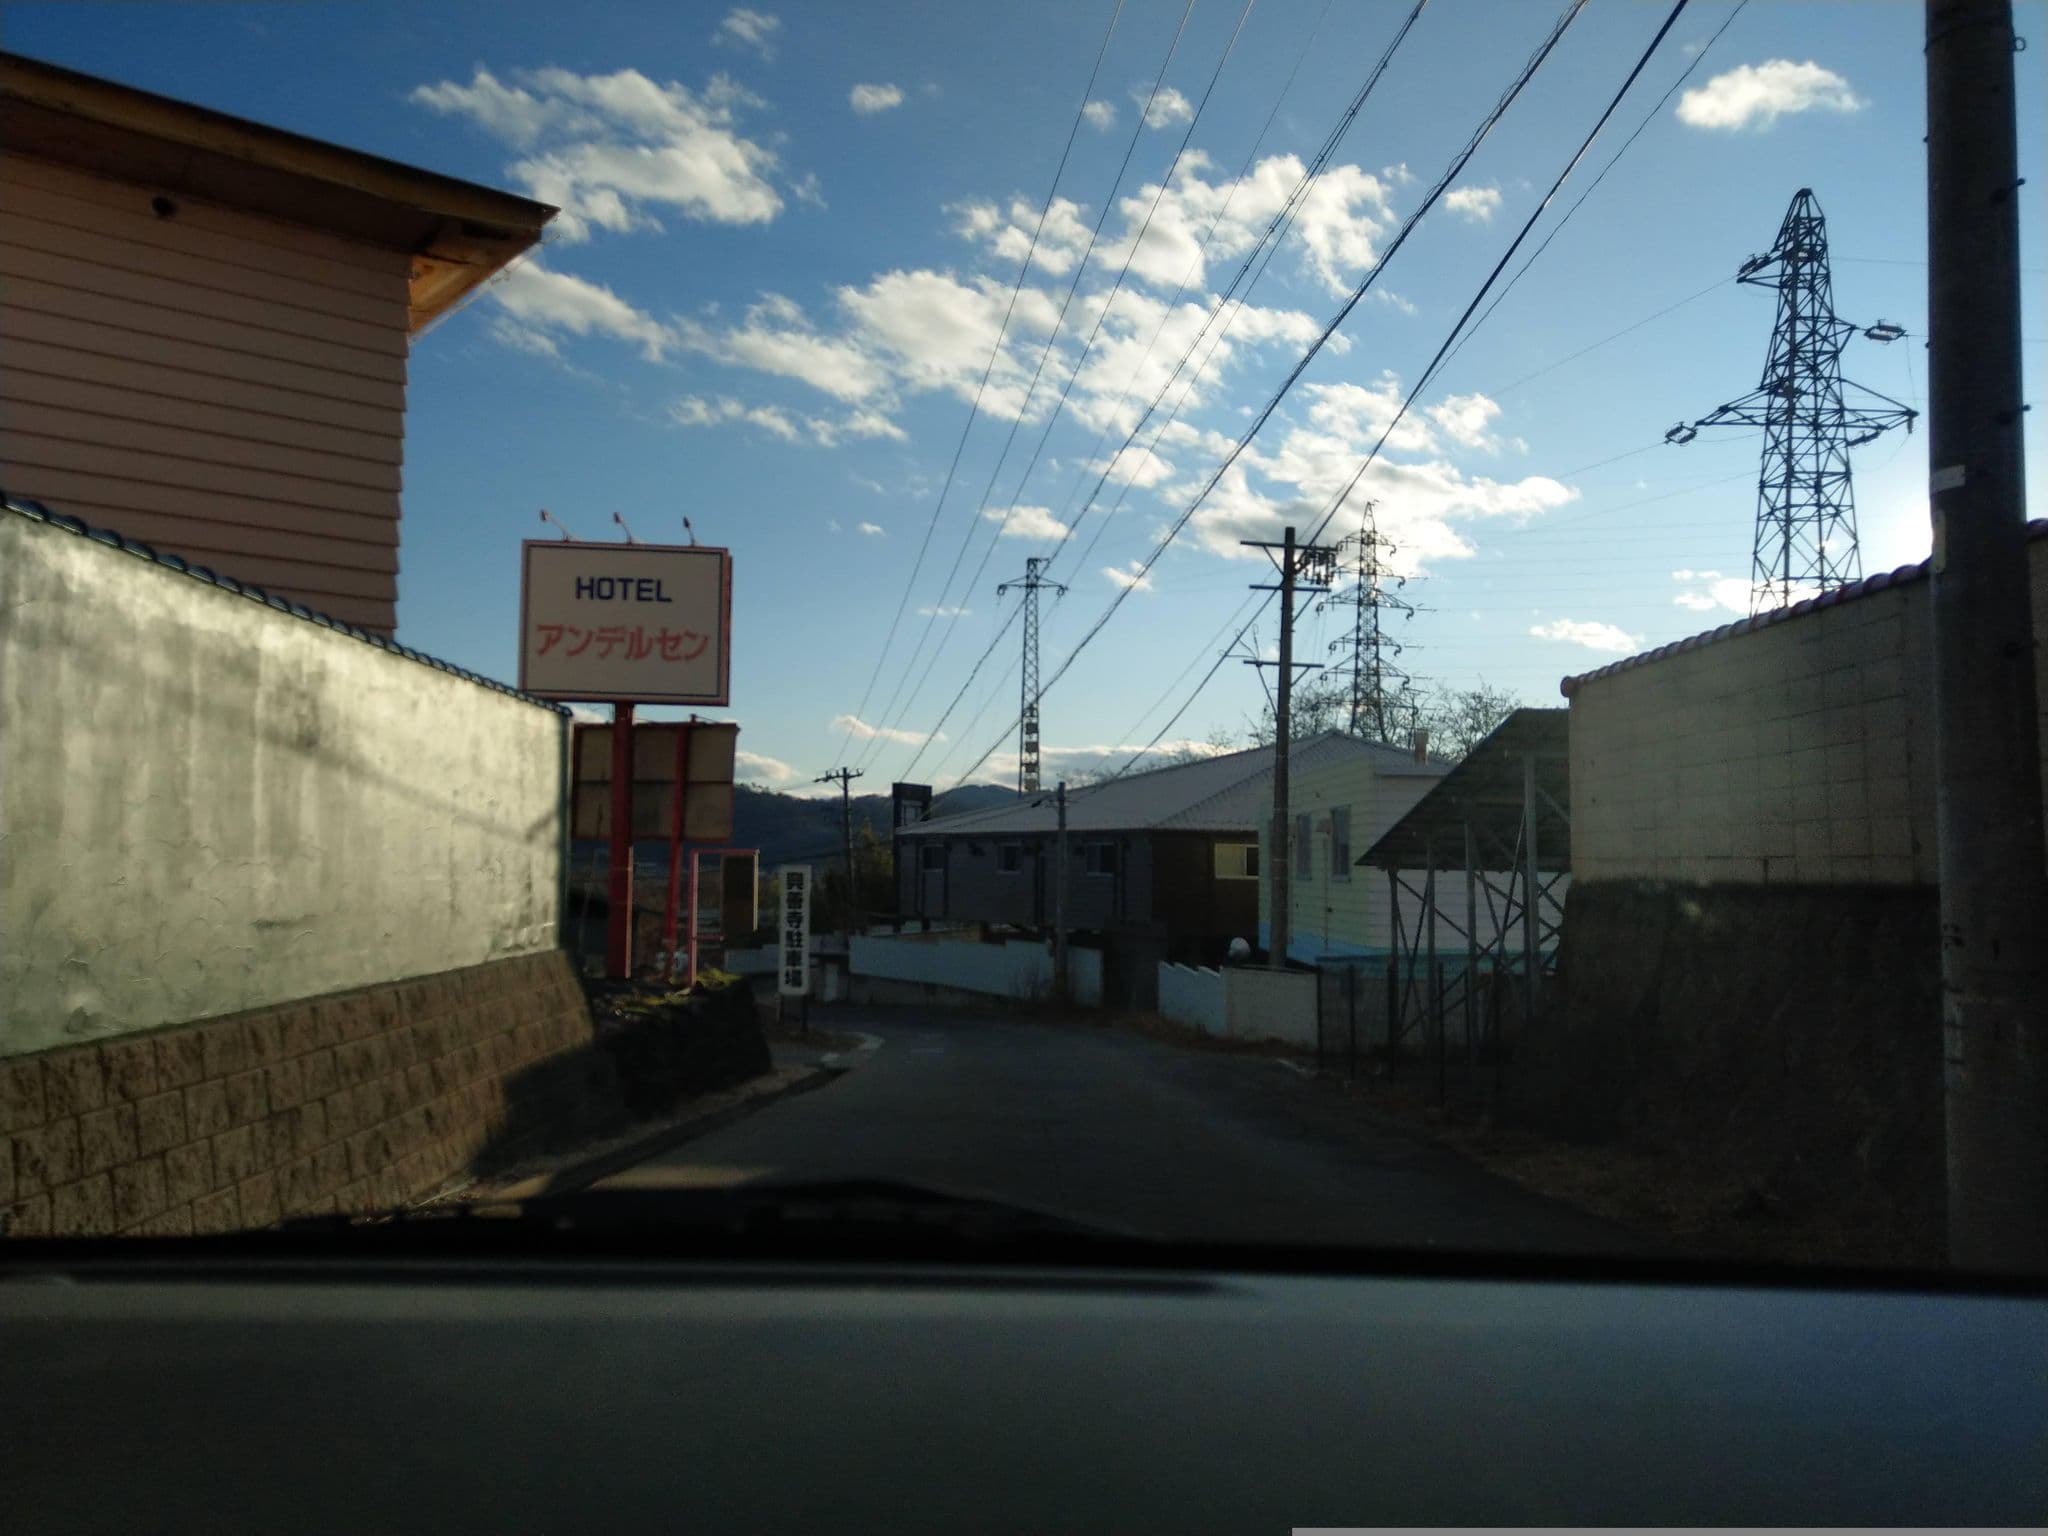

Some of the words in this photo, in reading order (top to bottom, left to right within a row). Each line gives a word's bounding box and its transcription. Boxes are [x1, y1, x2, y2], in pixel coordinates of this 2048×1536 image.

[576, 576, 672, 602] HOTEL
[537, 623, 709, 661] アンデルセン
